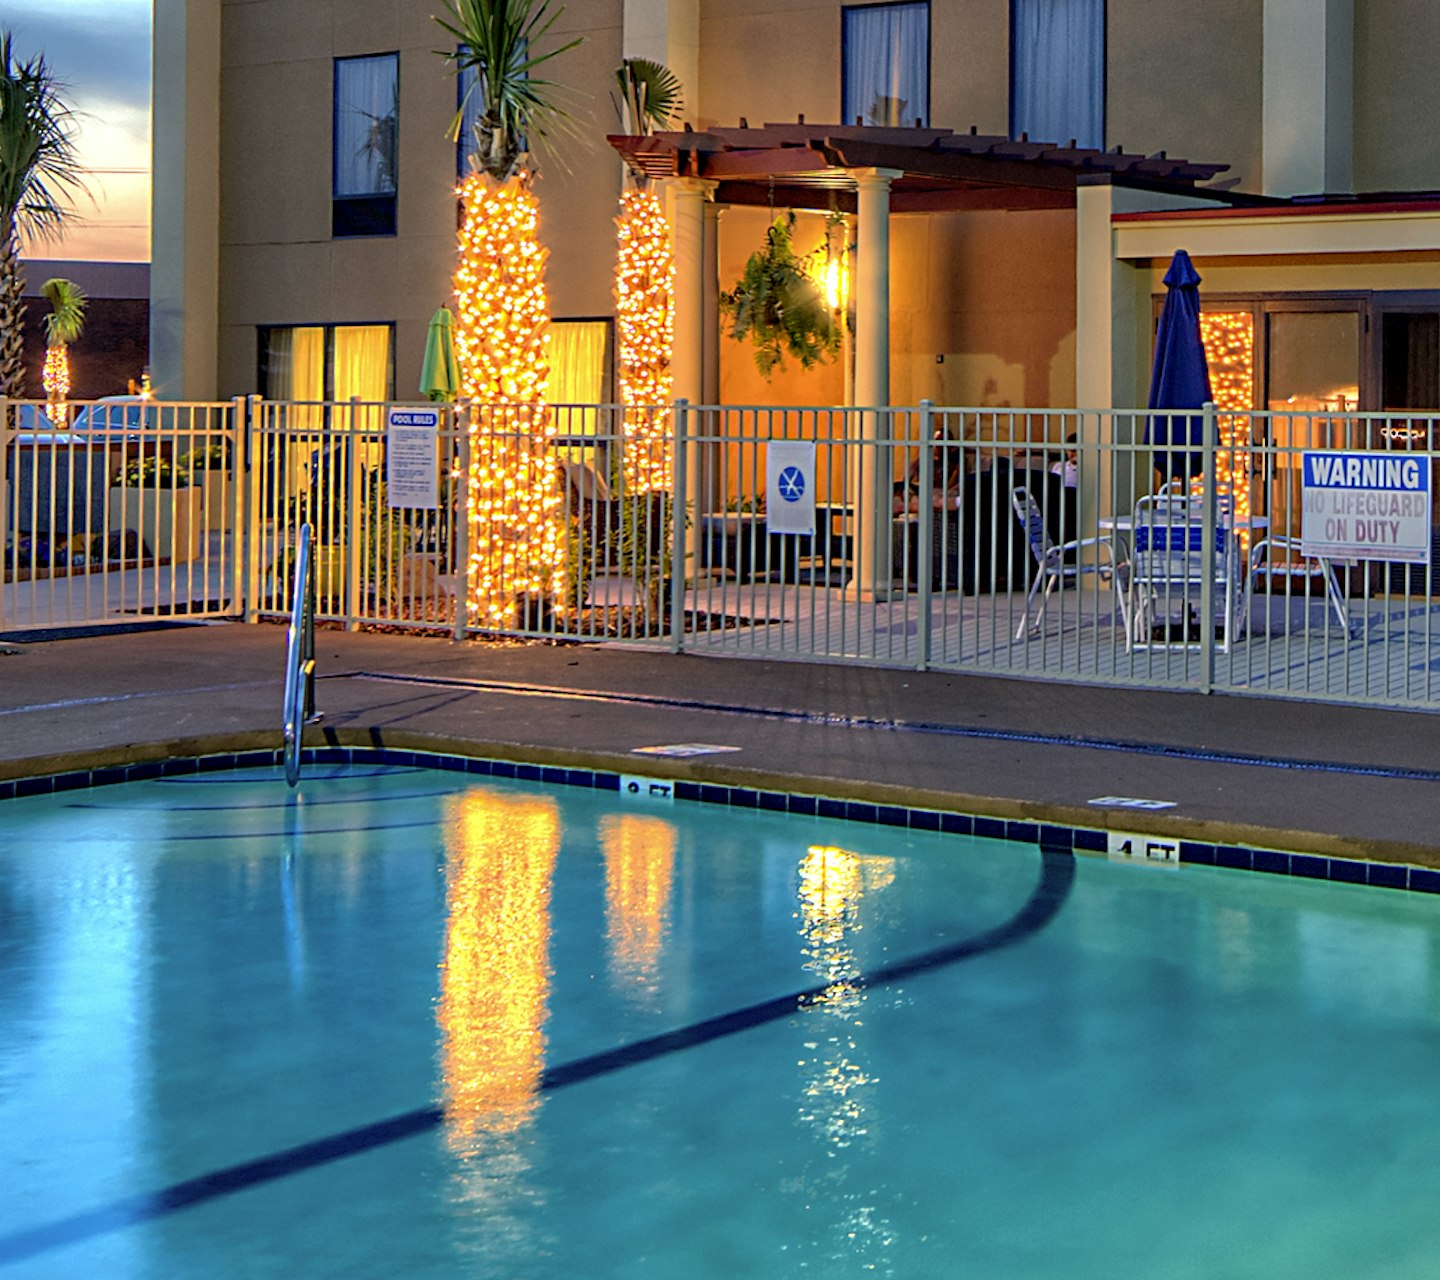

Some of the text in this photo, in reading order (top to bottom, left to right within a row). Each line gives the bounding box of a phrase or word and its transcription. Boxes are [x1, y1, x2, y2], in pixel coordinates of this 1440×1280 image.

[393, 414, 434, 425] POOL RULES
[1311, 457, 1419, 489] WARNING
[1305, 490, 1425, 517] NO LIFEGUARD
[1325, 518, 1400, 543] ON DUTY
[1147, 842, 1175, 859] FT
